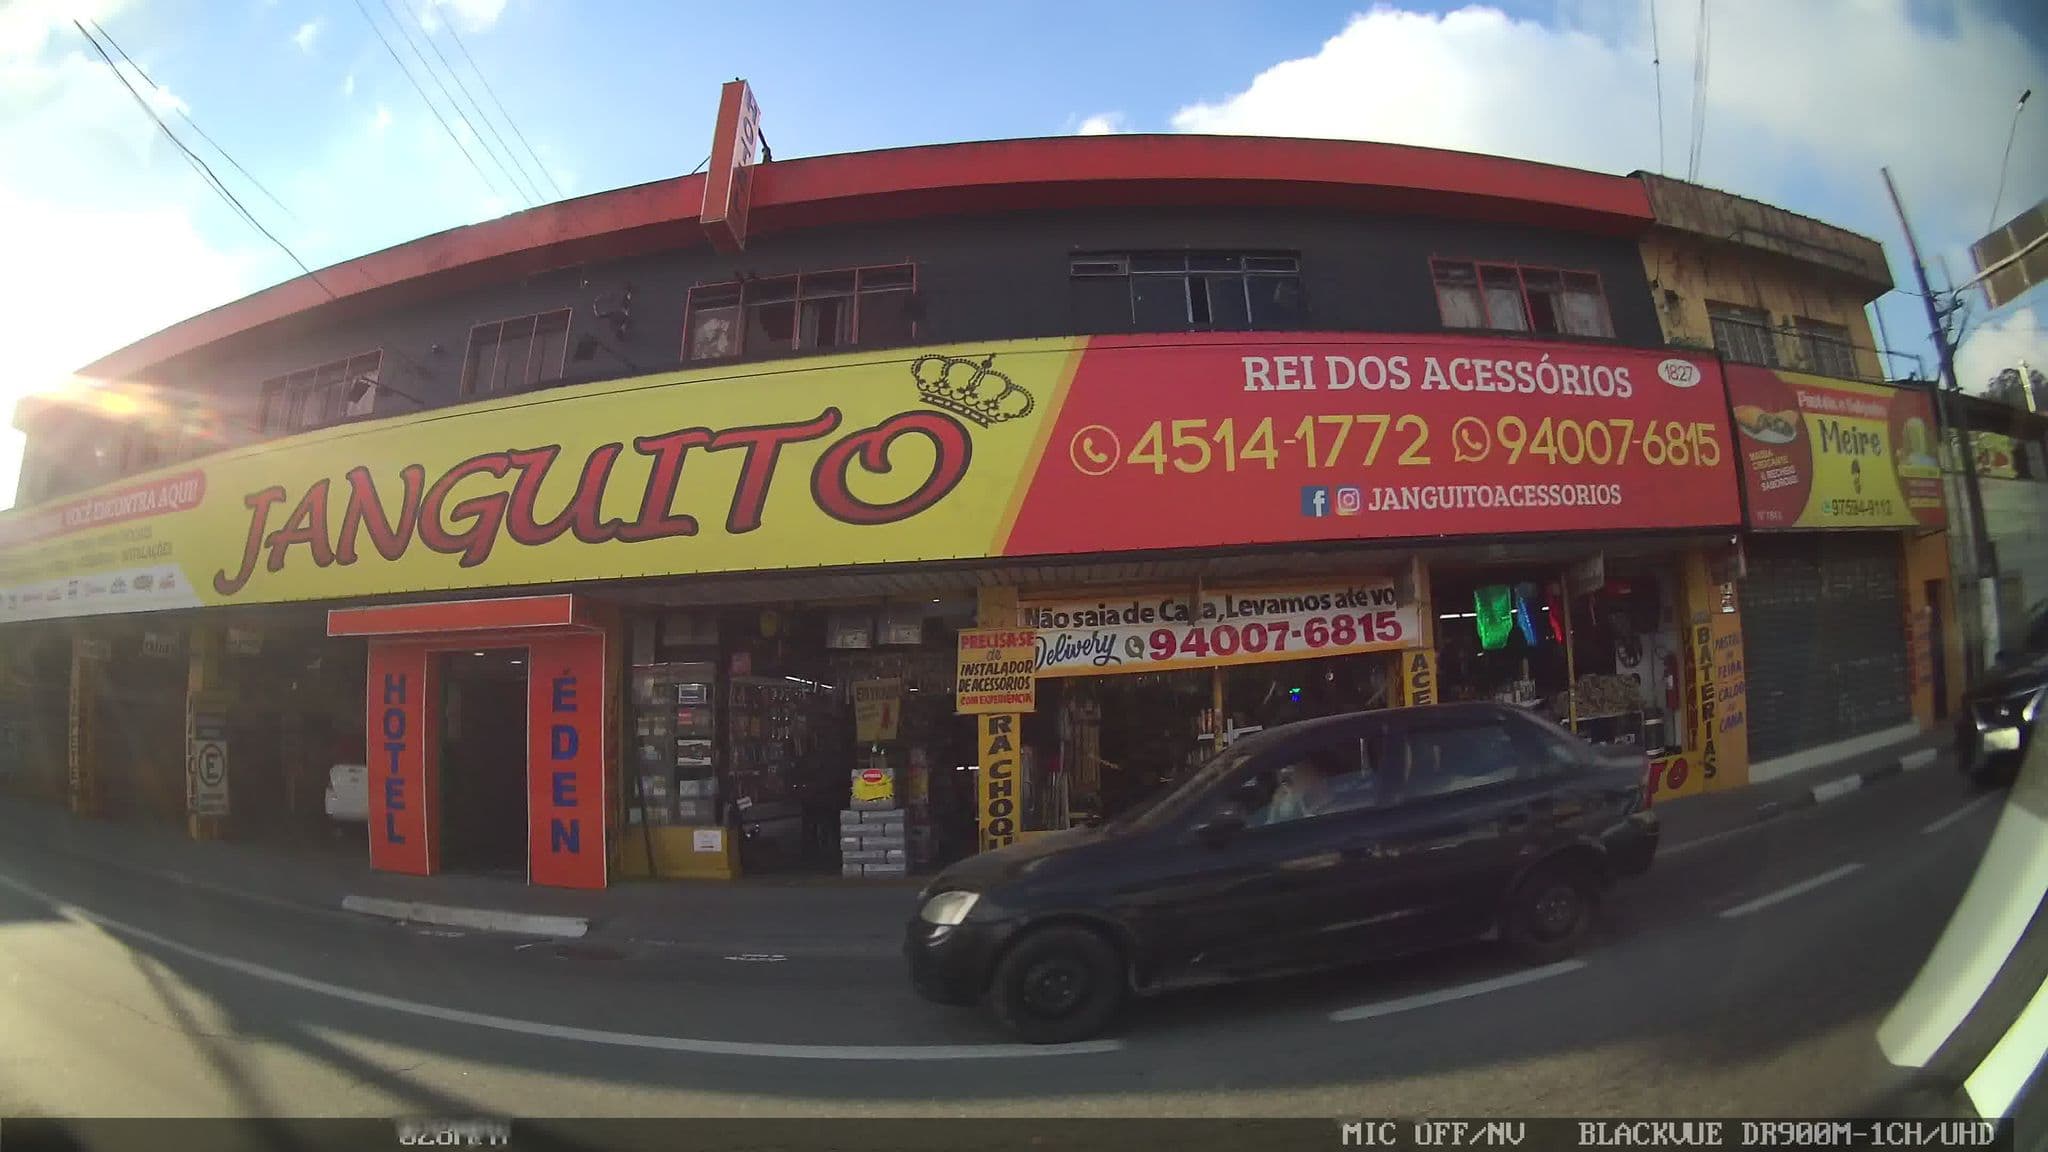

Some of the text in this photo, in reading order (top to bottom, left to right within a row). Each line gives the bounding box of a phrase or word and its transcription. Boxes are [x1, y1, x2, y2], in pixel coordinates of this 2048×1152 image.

[1242, 353, 1632, 398] REI DOS ACESSÓRIOS
[1664, 364, 1693, 382] 1827
[1127, 414, 1431, 475] 4514-1772
[1497, 415, 1720, 466] 94007-6815
[1818, 419, 1881, 456] Meire
[214, 407, 972, 595] JANGUITO
[1368, 484, 1622, 511] JANGUITOACESSORIOS
[1023, 586, 1400, 629] Não saia de Caa, Levamos até vo
[986, 648, 1001, 662] de
[1035, 610, 1402, 673] Delivery 94007-6815
[958, 679, 971, 692] DE
[960, 659, 1033, 677] INSTALADOR
[1697, 627, 1716, 779] BATERIAS
[384, 673, 406, 844] HOTEL
[552, 668, 580, 853] ÉDEN
